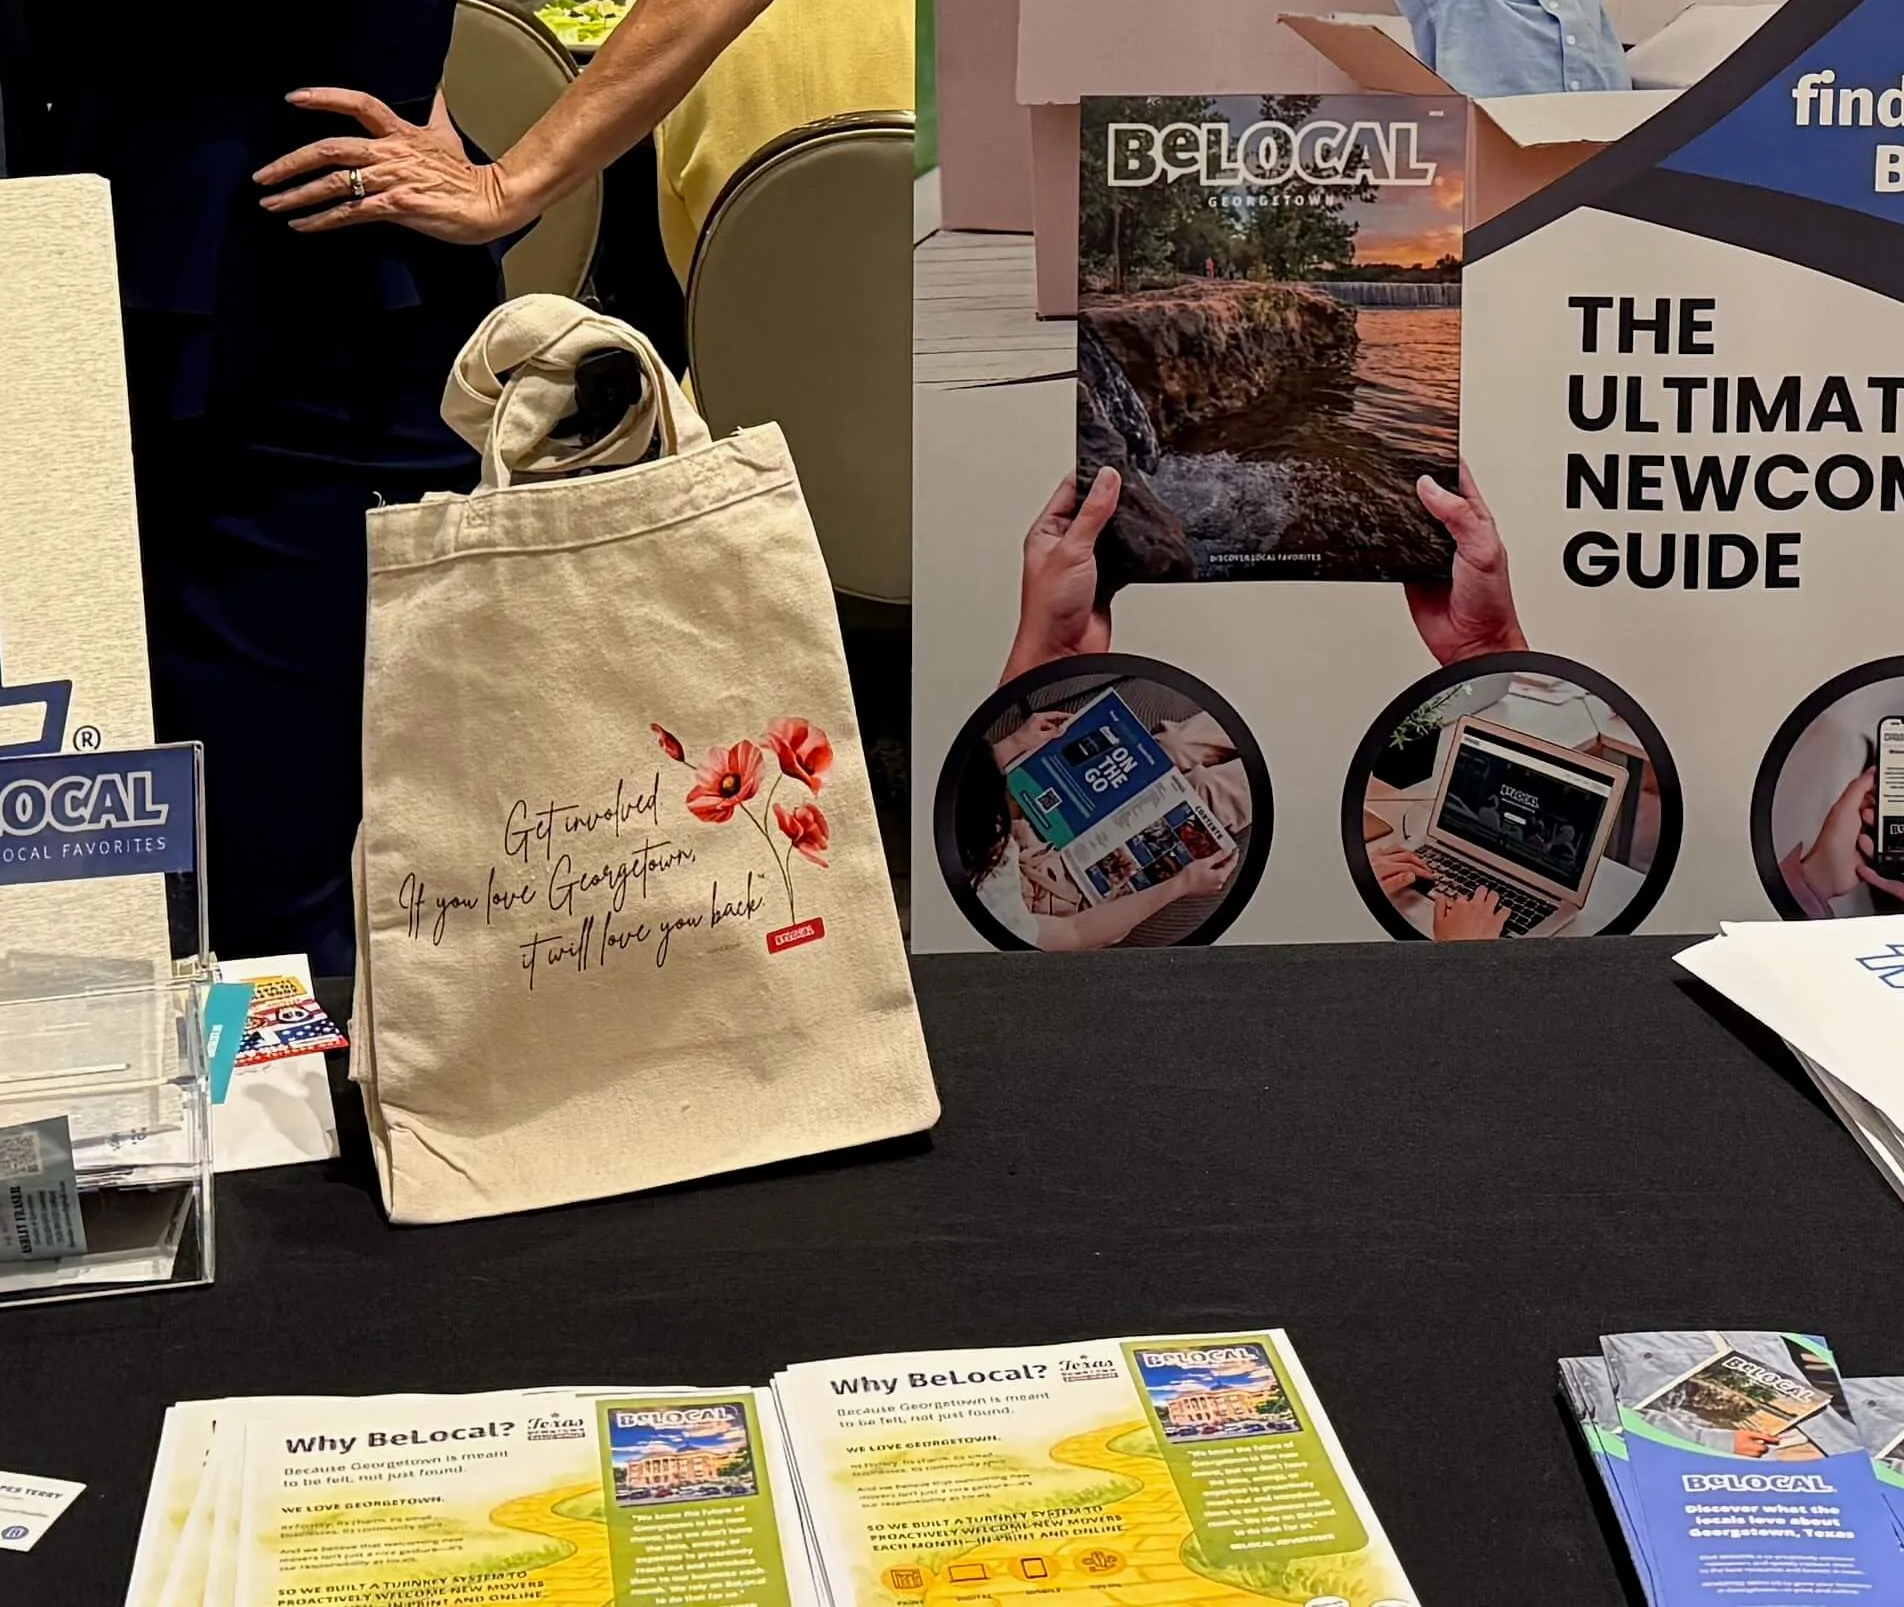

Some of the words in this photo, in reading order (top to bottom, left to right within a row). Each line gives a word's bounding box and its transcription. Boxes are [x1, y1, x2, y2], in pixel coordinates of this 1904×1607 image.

[1208, 195, 1334, 208] GEORGETOWN
[1567, 297, 1717, 355] THE
[1210, 554, 1250, 562] DISCOVER
[1251, 554, 1275, 562] LOCAL
[1278, 554, 1321, 562] FAVORITES
[1562, 532, 1802, 590] GUIDE
[1096, 755, 1129, 789] THE
[1112, 747, 1138, 774] ON
[1084, 769, 1109, 794] GO
[505, 800, 579, 862] Get
[62, 837, 166, 859] FAVORITES
[399, 873, 424, 940] If
[436, 896, 479, 945] you
[487, 867, 537, 925] love
[520, 933, 563, 990] it
[548, 916, 594, 972] will
[601, 912, 651, 966] love
[656, 914, 703, 968] you
[830, 1375, 898, 1395] Why
[909, 1364, 1048, 1390] BeLocal?
[837, 1405, 895, 1417] Because
[900, 1398, 987, 1414] Georgetown
[990, 1395, 1001, 1403] is
[1005, 1391, 1050, 1402] meant
[840, 1420, 855, 1429] to
[859, 1419, 876, 1427] be
[911, 1413, 934, 1423] not
[938, 1410, 964, 1422] just
[286, 1435, 357, 1455] Why
[368, 1421, 516, 1449] BeLocal?
[846, 1446, 865, 1454] WE
[869, 1443, 902, 1452] LOVE
[905, 1435, 1002, 1449] GEORGETOWN.
[25, 1488, 63, 1499] TERRY
[281, 1506, 302, 1514] WE
[306, 1502, 340, 1513] LOVE
[345, 1496, 445, 1510] GEORGETOWN.
[1685, 1504, 1759, 1514] Discover
[1762, 1504, 1807, 1514] what
[1810, 1506, 1840, 1515] the
[867, 1524, 885, 1532] SO
[888, 1521, 909, 1531] WE
[913, 1518, 950, 1529] BUILT
[954, 1516, 964, 1525] A
[869, 1530, 958, 1542] PROACTIVELY
[1033, 1519, 1064, 1529] NEW
[1067, 1515, 1123, 1526] MOVERS
[1696, 1516, 1745, 1525] locals
[1749, 1516, 1786, 1525] love
[1790, 1517, 1840, 1527] about
[1689, 1528, 1801, 1538] Georgetown,
[1803, 1528, 1855, 1539] Texas
[872, 1542, 909, 1552] EACH
